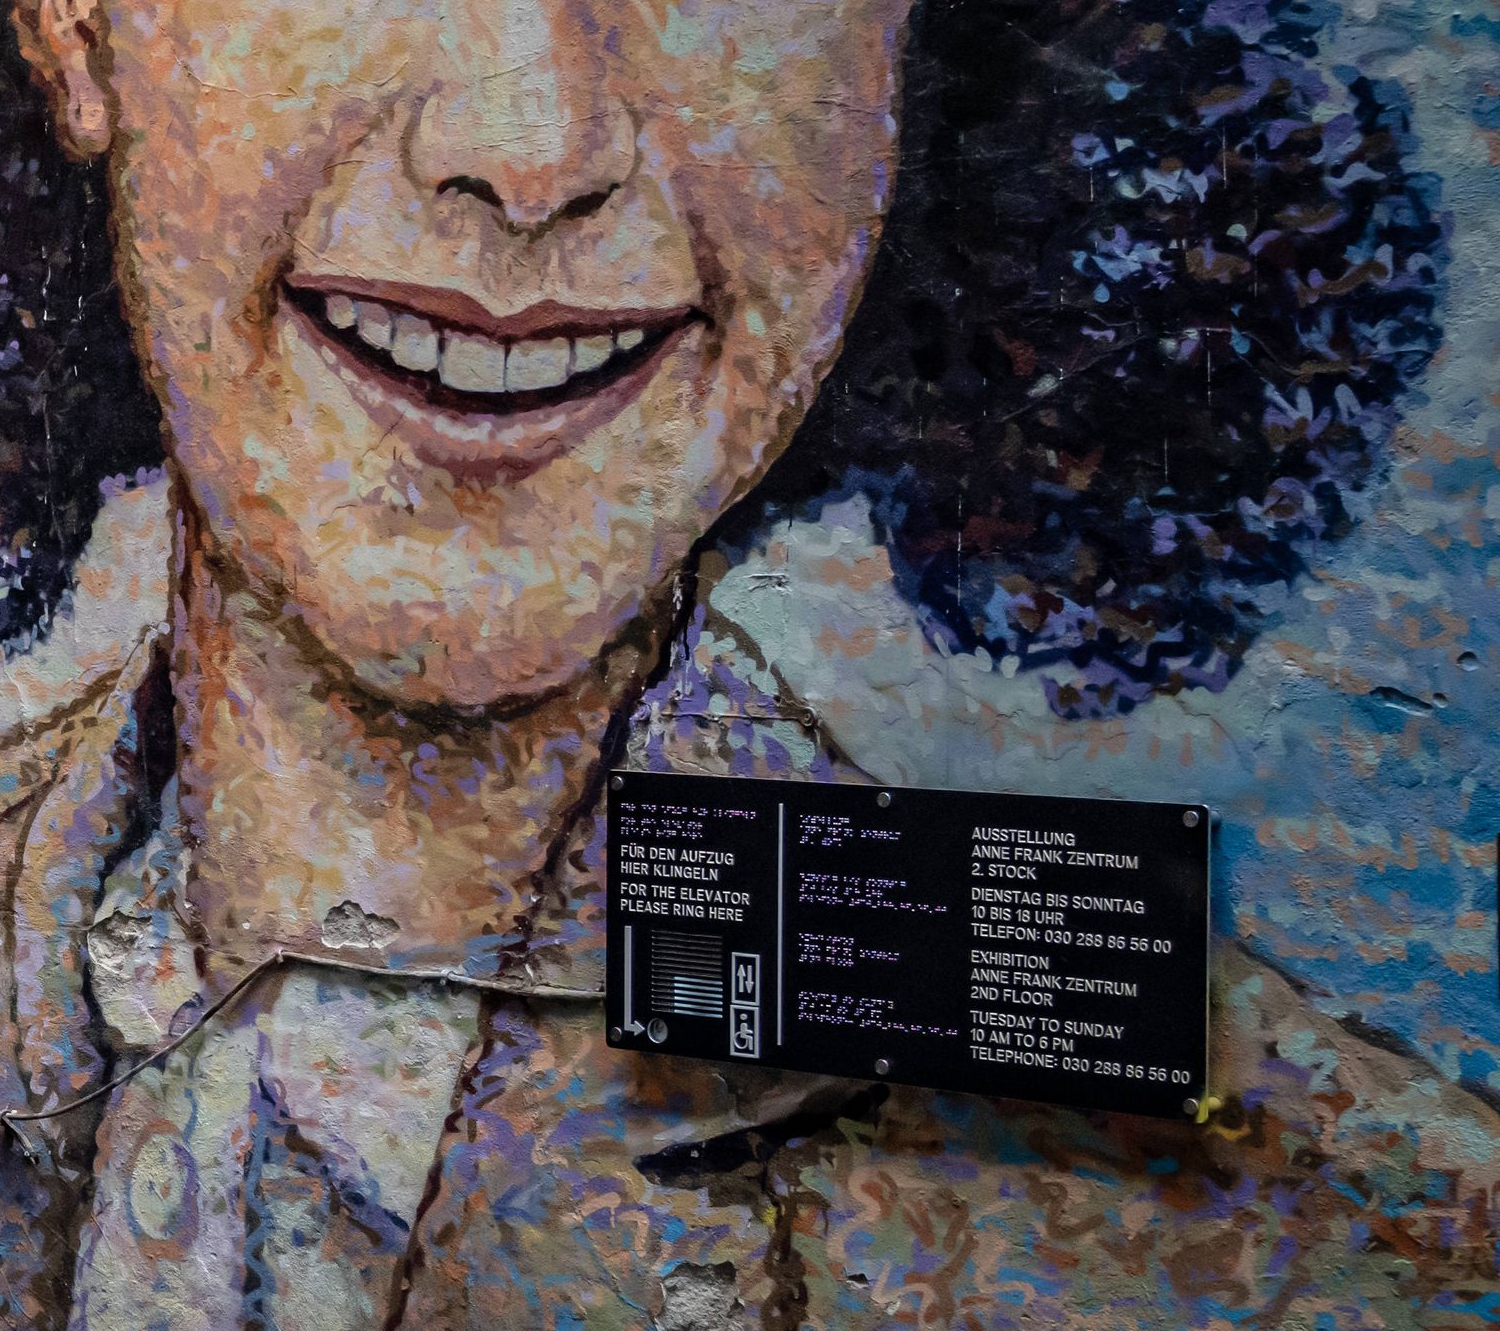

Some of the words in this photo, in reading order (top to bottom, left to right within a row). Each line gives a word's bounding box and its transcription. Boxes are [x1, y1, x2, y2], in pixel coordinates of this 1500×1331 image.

[971, 827, 1075, 847] AUSSTELLUNG
[621, 842, 645, 859] FÜR
[649, 847, 676, 861] DEN
[680, 849, 735, 866] AUFZUG
[971, 845, 1010, 860] ANNE
[1014, 847, 1063, 864] FRANK
[1067, 851, 1138, 869] ZENTRUM
[621, 861, 649, 876] HIER
[653, 864, 718, 881] KLINGELN
[971, 863, 984, 876] 2.
[988, 864, 1037, 880] STOCK
[621, 882, 647, 897] FOR
[651, 885, 676, 899] THE
[680, 887, 750, 906] ELEVATOR
[971, 887, 1042, 905] DIENSTAG
[1046, 894, 1068, 908] BIS
[1072, 895, 1145, 915] SONNTAG
[621, 899, 669, 915] PLEASE
[673, 903, 704, 918] RING
[709, 906, 743, 922] HERE
[971, 905, 985, 919] 10
[990, 907, 1012, 921] BIS
[1015, 909, 1030, 923] 18
[1035, 911, 1064, 926] UHR
[971, 922, 1041, 942] TELEFON:
[1044, 930, 1072, 945] 030
[1076, 933, 1103, 947] 288
[1107, 935, 1126, 949] 86
[1130, 937, 1149, 952] 56
[1153, 939, 1172, 954] 00
[971, 949, 1050, 970] EXHIBITION
[970, 968, 1009, 984] ANNE
[1013, 971, 1062, 990] FRANK
[1065, 976, 1137, 997] ZENTRUM
[970, 986, 999, 1001] 2ND
[1003, 988, 1053, 1007] FLOOR
[969, 1009, 1035, 1030] TUESDAY
[1038, 1017, 1059, 1033] TO
[1064, 1021, 1124, 1040] SUNDAY
[970, 1028, 985, 1042] 10
[989, 1030, 1010, 1045] AM
[1014, 1032, 1035, 1048] TO
[1039, 1036, 1048, 1050] 6
[1052, 1037, 1074, 1052] PM
[969, 1045, 1058, 1069] TELEPHONE:
[1062, 1056, 1090, 1073] 030
[1093, 1059, 1121, 1076] 288
[1125, 1064, 1144, 1079] 86
[1148, 1066, 1167, 1082] 56
[1171, 1069, 1190, 1085] 00
